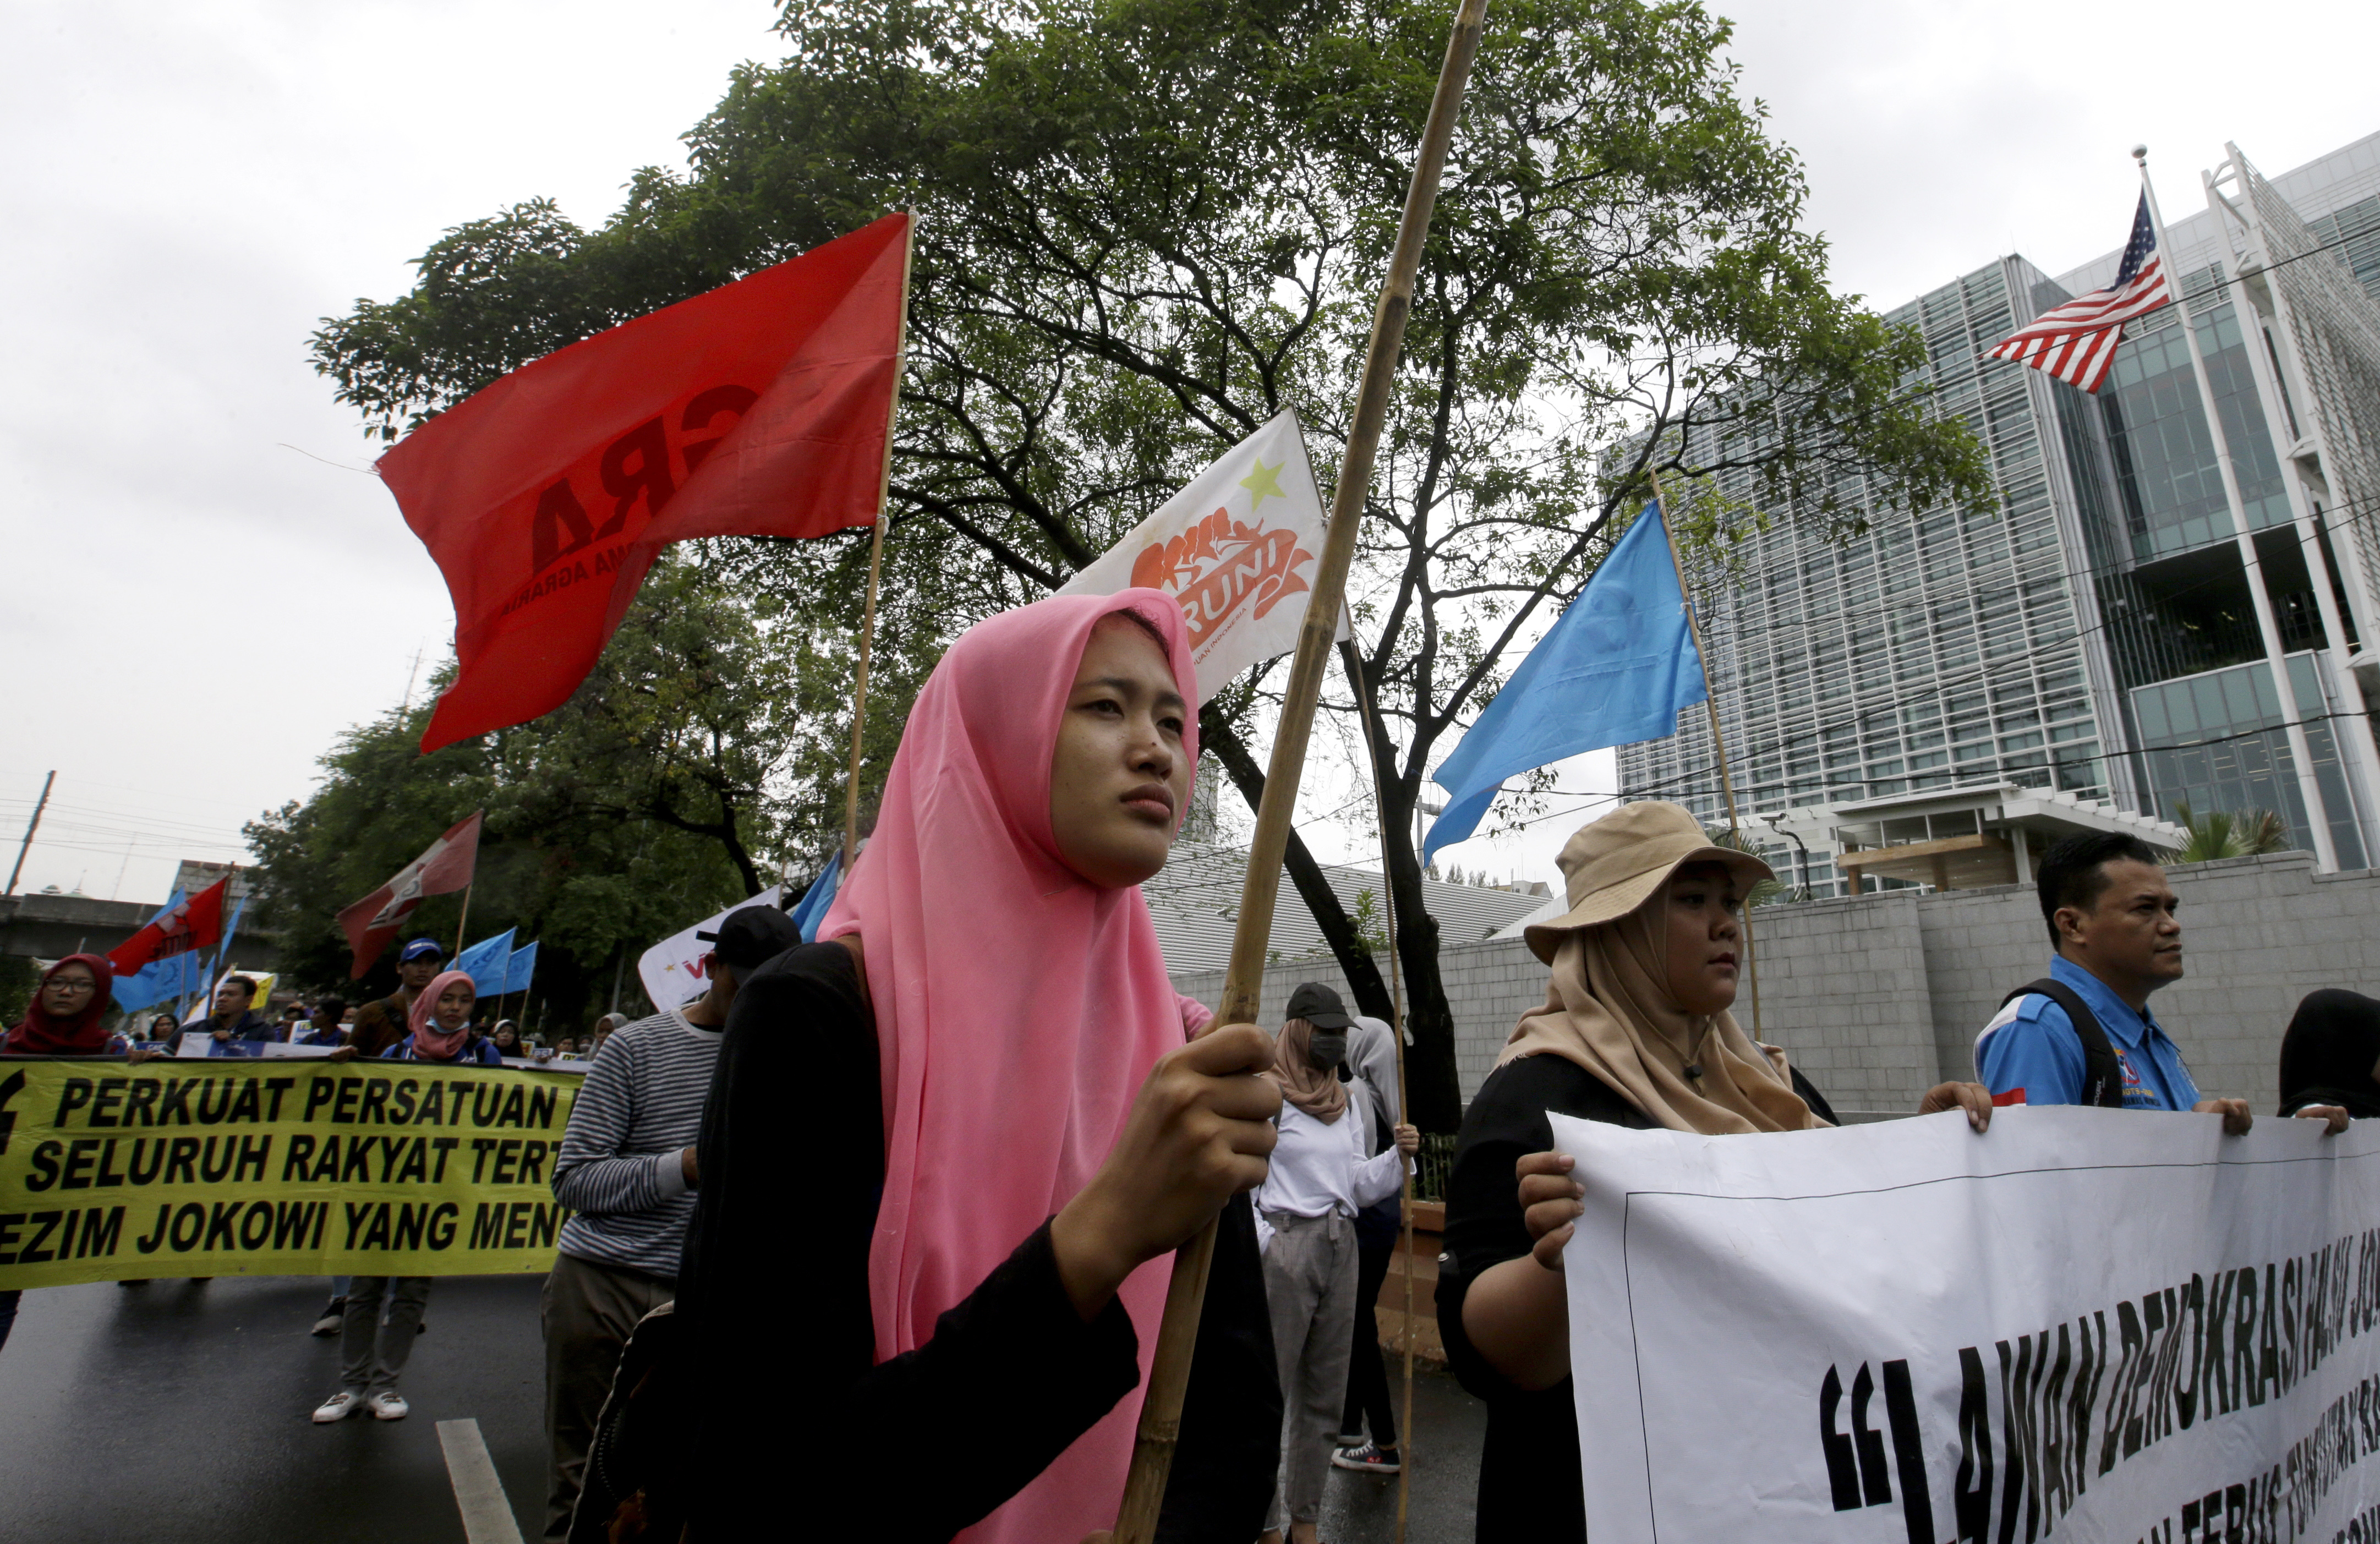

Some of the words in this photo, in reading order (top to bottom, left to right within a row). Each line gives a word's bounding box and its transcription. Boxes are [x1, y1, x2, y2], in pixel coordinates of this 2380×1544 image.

[1211, 607, 1246, 648] INDONESIA
[53, 1077, 296, 1128] PERKUAT
[303, 1077, 558, 1130] PERSATUAN
[25, 1134, 273, 1191] SELURUH
[282, 1134, 459, 1183] RAKYAT
[136, 1201, 329, 1253] JOKOWI
[344, 1202, 459, 1251] YANG
[2098, 1256, 2302, 1477] DEMOKRASI
